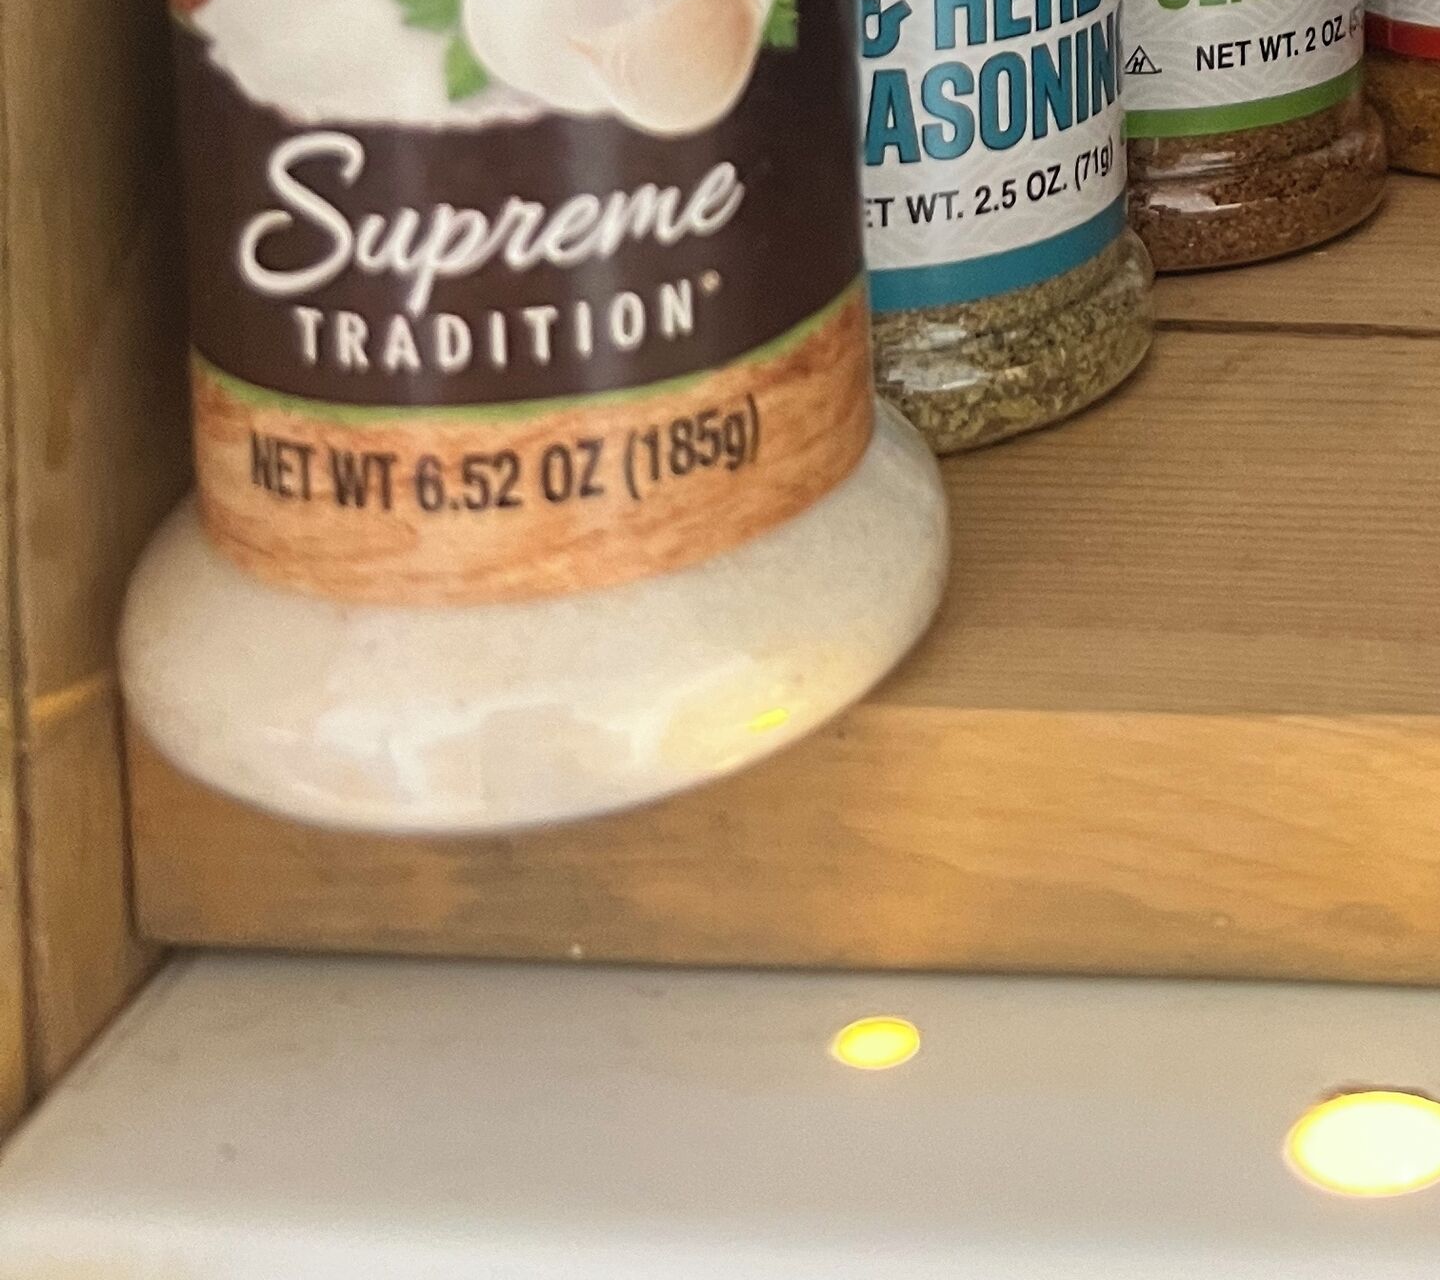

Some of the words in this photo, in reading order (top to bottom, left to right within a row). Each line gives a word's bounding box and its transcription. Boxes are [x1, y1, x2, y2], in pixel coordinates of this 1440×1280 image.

[1196, 39, 1251, 71] NET
[1259, 31, 1299, 63] WT.
[1305, 26, 1316, 53] 2
[1321, 15, 1346, 47] OZ
[238, 130, 746, 315] Supreme
[906, 189, 964, 225] WT.
[974, 178, 1017, 216] 2.5
[1026, 164, 1068, 203] OZ.
[1074, 135, 1113, 191] (71g)
[293, 278, 697, 373] TRADITION
[251, 428, 315, 504] NET
[329, 443, 397, 511] WT
[415, 447, 523, 513] 6.52
[541, 436, 605, 505] OZ
[625, 394, 760, 503] (185g)
